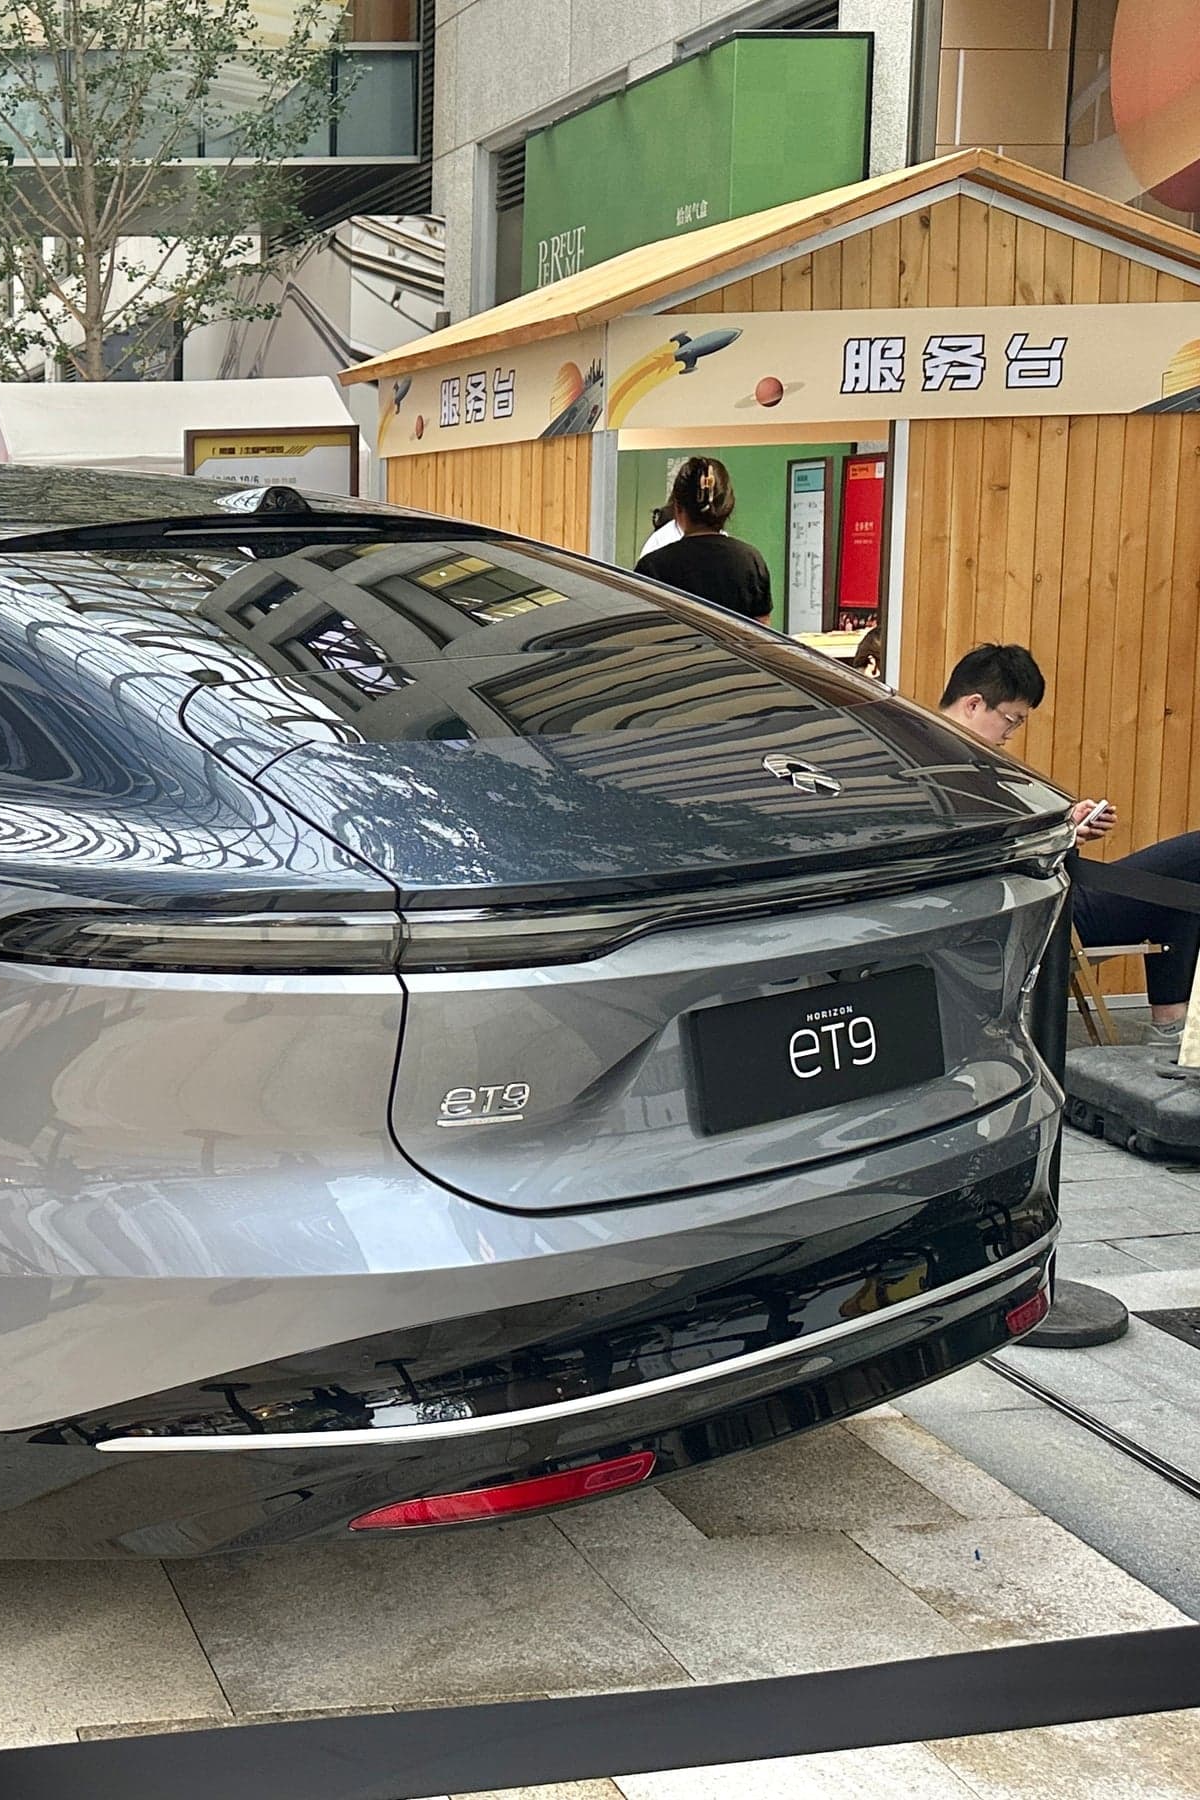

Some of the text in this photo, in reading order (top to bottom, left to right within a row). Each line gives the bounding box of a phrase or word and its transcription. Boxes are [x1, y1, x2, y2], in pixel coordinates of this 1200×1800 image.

[840, 333, 1068, 393] 服务台
[440, 367, 516, 428] 服务台
[806, 1005, 853, 1022] HORIZON
